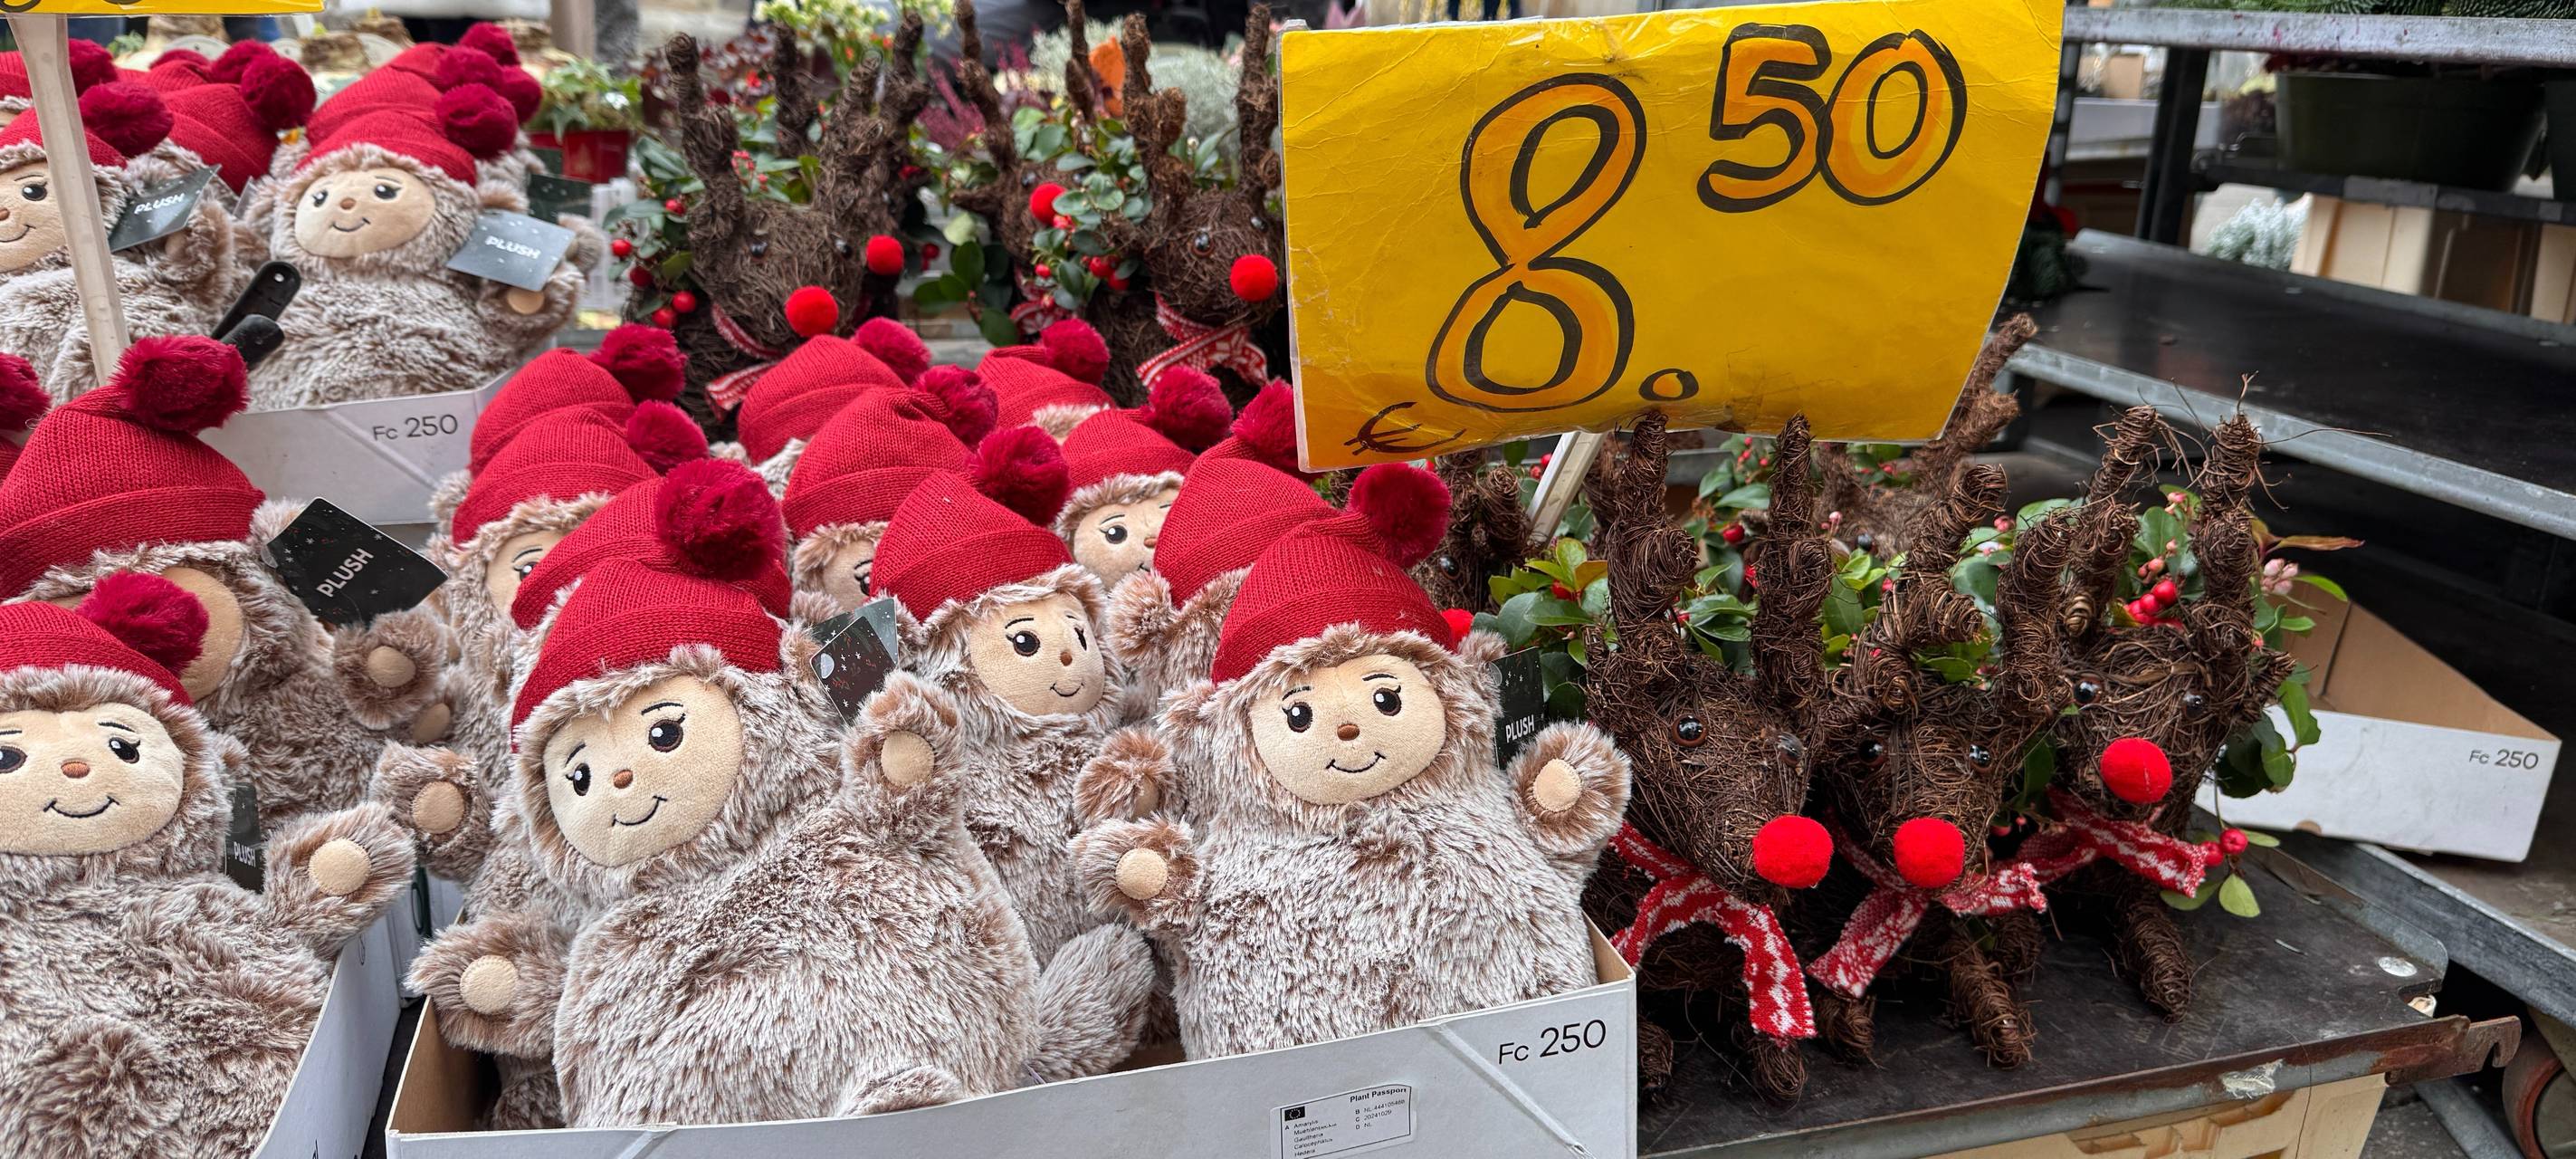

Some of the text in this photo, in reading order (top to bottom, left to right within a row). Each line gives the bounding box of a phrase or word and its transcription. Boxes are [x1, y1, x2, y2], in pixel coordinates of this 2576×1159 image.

[133, 192, 186, 215] PLUSH
[484, 235, 542, 260] PLUSH
[372, 414, 459, 441] Fc 250
[1343, 400, 1467, 456] €
[316, 547, 375, 598] PLUSH
[1505, 714, 1535, 743] PLUSH
[2469, 748, 2539, 770] Fc 250
[234, 841, 256, 868] PLUSH
[1498, 1019, 1607, 1065] Fc 250
[1350, 1092, 1369, 1103] Plant
